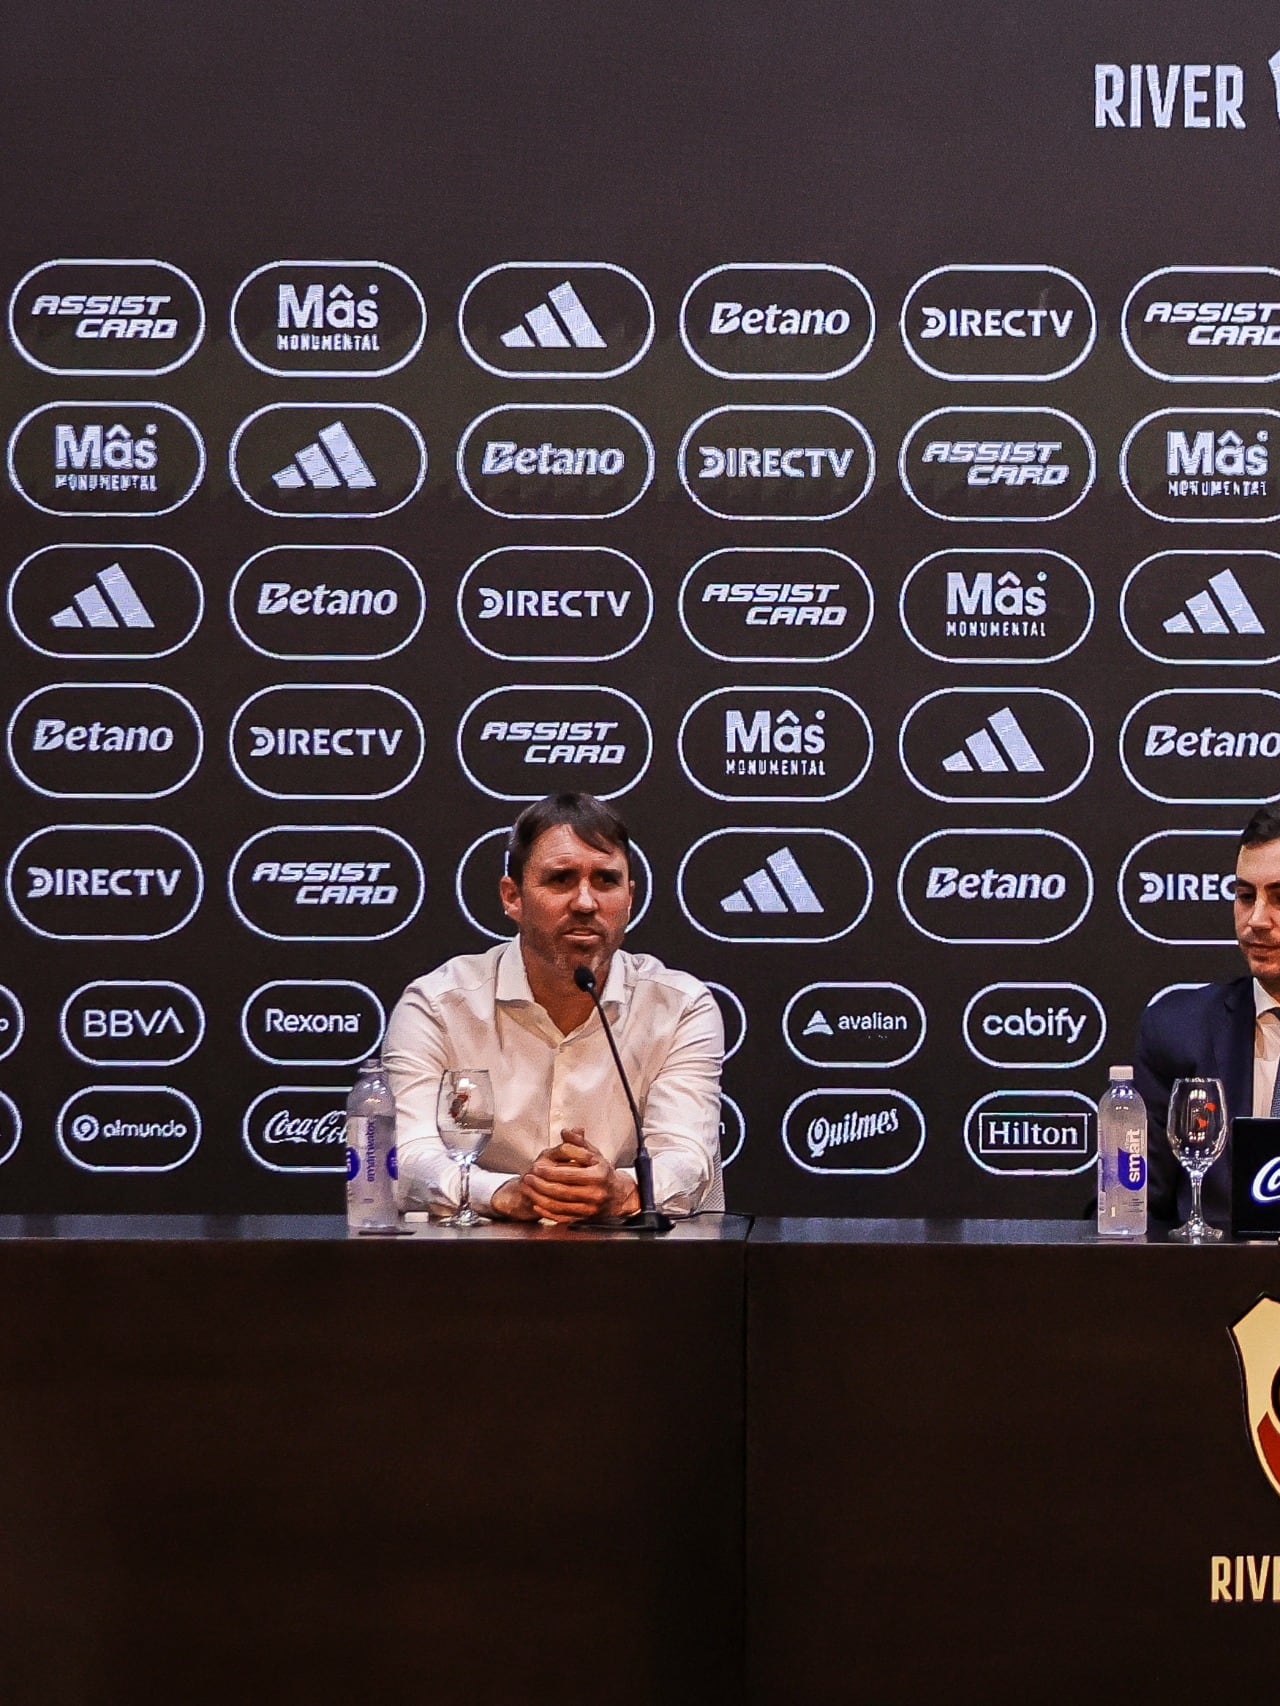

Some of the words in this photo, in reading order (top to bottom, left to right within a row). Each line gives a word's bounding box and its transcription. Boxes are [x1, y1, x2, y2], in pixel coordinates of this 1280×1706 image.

[1094, 63, 1246, 129] RIVER
[31, 294, 172, 316] ASSIST
[75, 318, 178, 339] CARD
[709, 302, 851, 336] Betano
[920, 306, 1074, 339] DIRECTV
[276, 332, 380, 352] MONUMENTAL
[481, 441, 625, 476] Betano
[698, 446, 855, 479] DIRECTV
[921, 440, 1063, 464] ASSIST
[967, 464, 1070, 486] CARD
[257, 582, 398, 616] Betano
[478, 587, 632, 619] DIRECTV
[701, 583, 840, 603] ASSIST
[745, 605, 848, 626] CARD
[946, 620, 1046, 638] MONUMENTAL
[32, 719, 174, 752] Betano
[249, 726, 403, 757] DIRECTV
[480, 721, 619, 742] ASSIST
[523, 744, 626, 764] CARD
[725, 759, 826, 776] MONUMENTAL
[27, 866, 182, 898] DIRECTV
[251, 862, 391, 883] ASSIST
[925, 867, 1066, 900] Betano
[295, 885, 399, 905] CARD
[1138, 871, 1237, 904] DIREC
[83, 1006, 185, 1038] BBVA
[265, 1008, 359, 1033] Rexona
[838, 1011, 908, 1031] avalian
[982, 1007, 1087, 1044] cabify
[103, 1119, 188, 1138] almundo
[807, 1108, 899, 1158] Quilmes
[988, 1120, 1079, 1146] Hilton
[1126, 1128, 1141, 1183] smart
